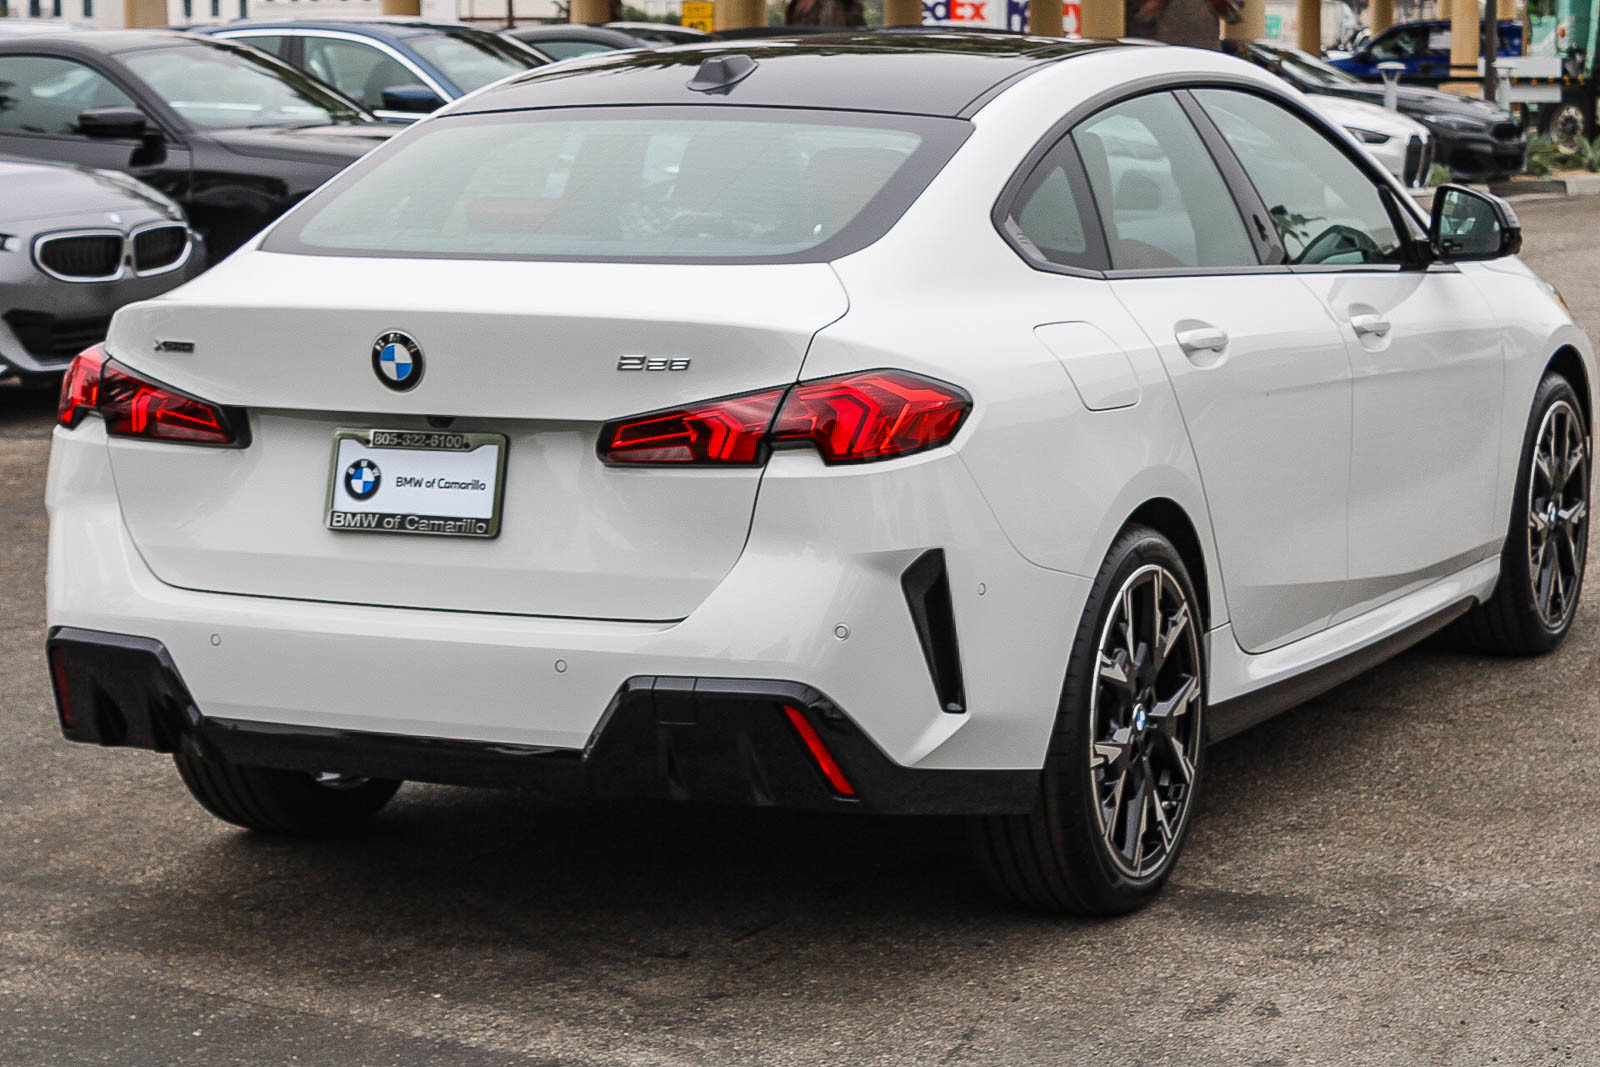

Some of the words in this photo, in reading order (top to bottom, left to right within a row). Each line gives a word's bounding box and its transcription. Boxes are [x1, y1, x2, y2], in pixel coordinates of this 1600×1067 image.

[374, 433, 462, 448] 805-322-6100
[396, 476, 423, 487] BMW
[425, 478, 436, 488] of
[437, 478, 486, 491] Camarillo
[332, 512, 379, 527] BMW
[383, 515, 402, 529] of
[405, 516, 487, 534] Camarillo
